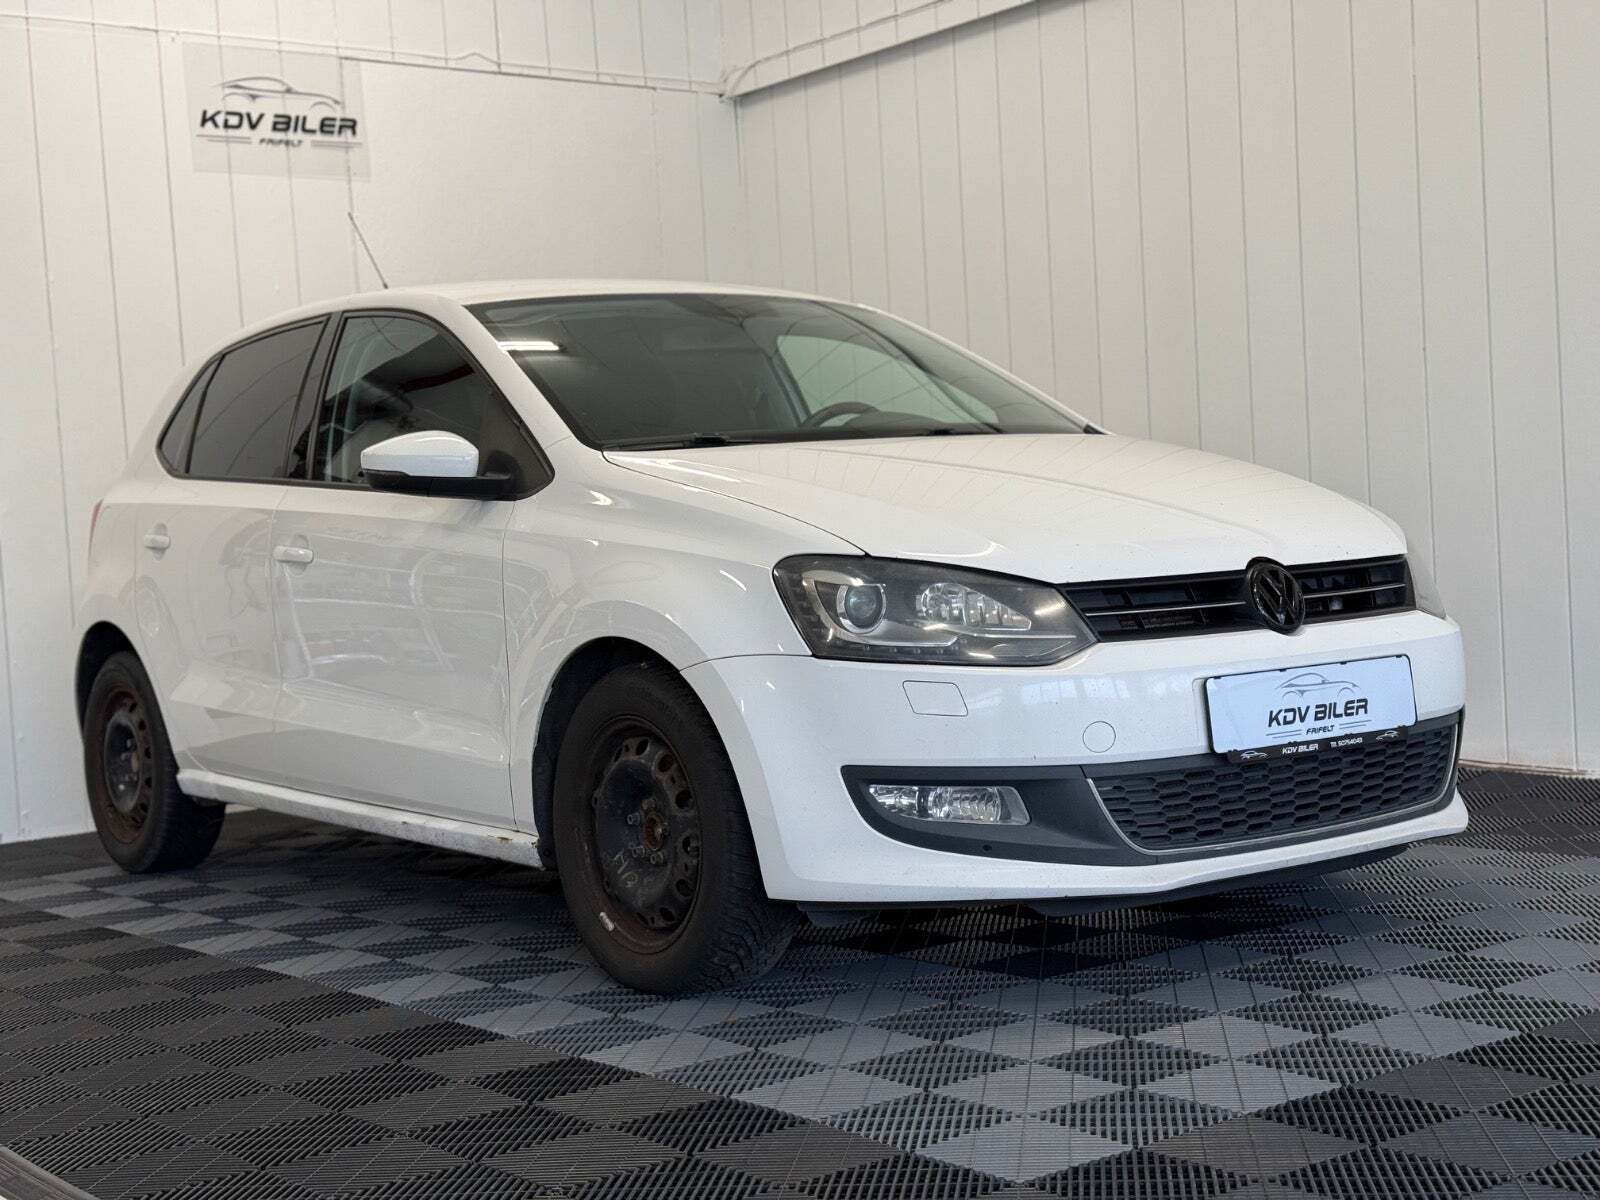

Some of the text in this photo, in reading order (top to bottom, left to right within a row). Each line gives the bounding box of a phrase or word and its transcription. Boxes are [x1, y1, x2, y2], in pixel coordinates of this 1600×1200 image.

[200, 109, 358, 136] KDV BILER
[259, 138, 304, 148] FRIFELT
[1267, 698, 1369, 728] KDV BILER
[1305, 724, 1335, 736] FRIFELT
[1282, 745, 1298, 755] KDV
[1298, 743, 1319, 753] BILER
